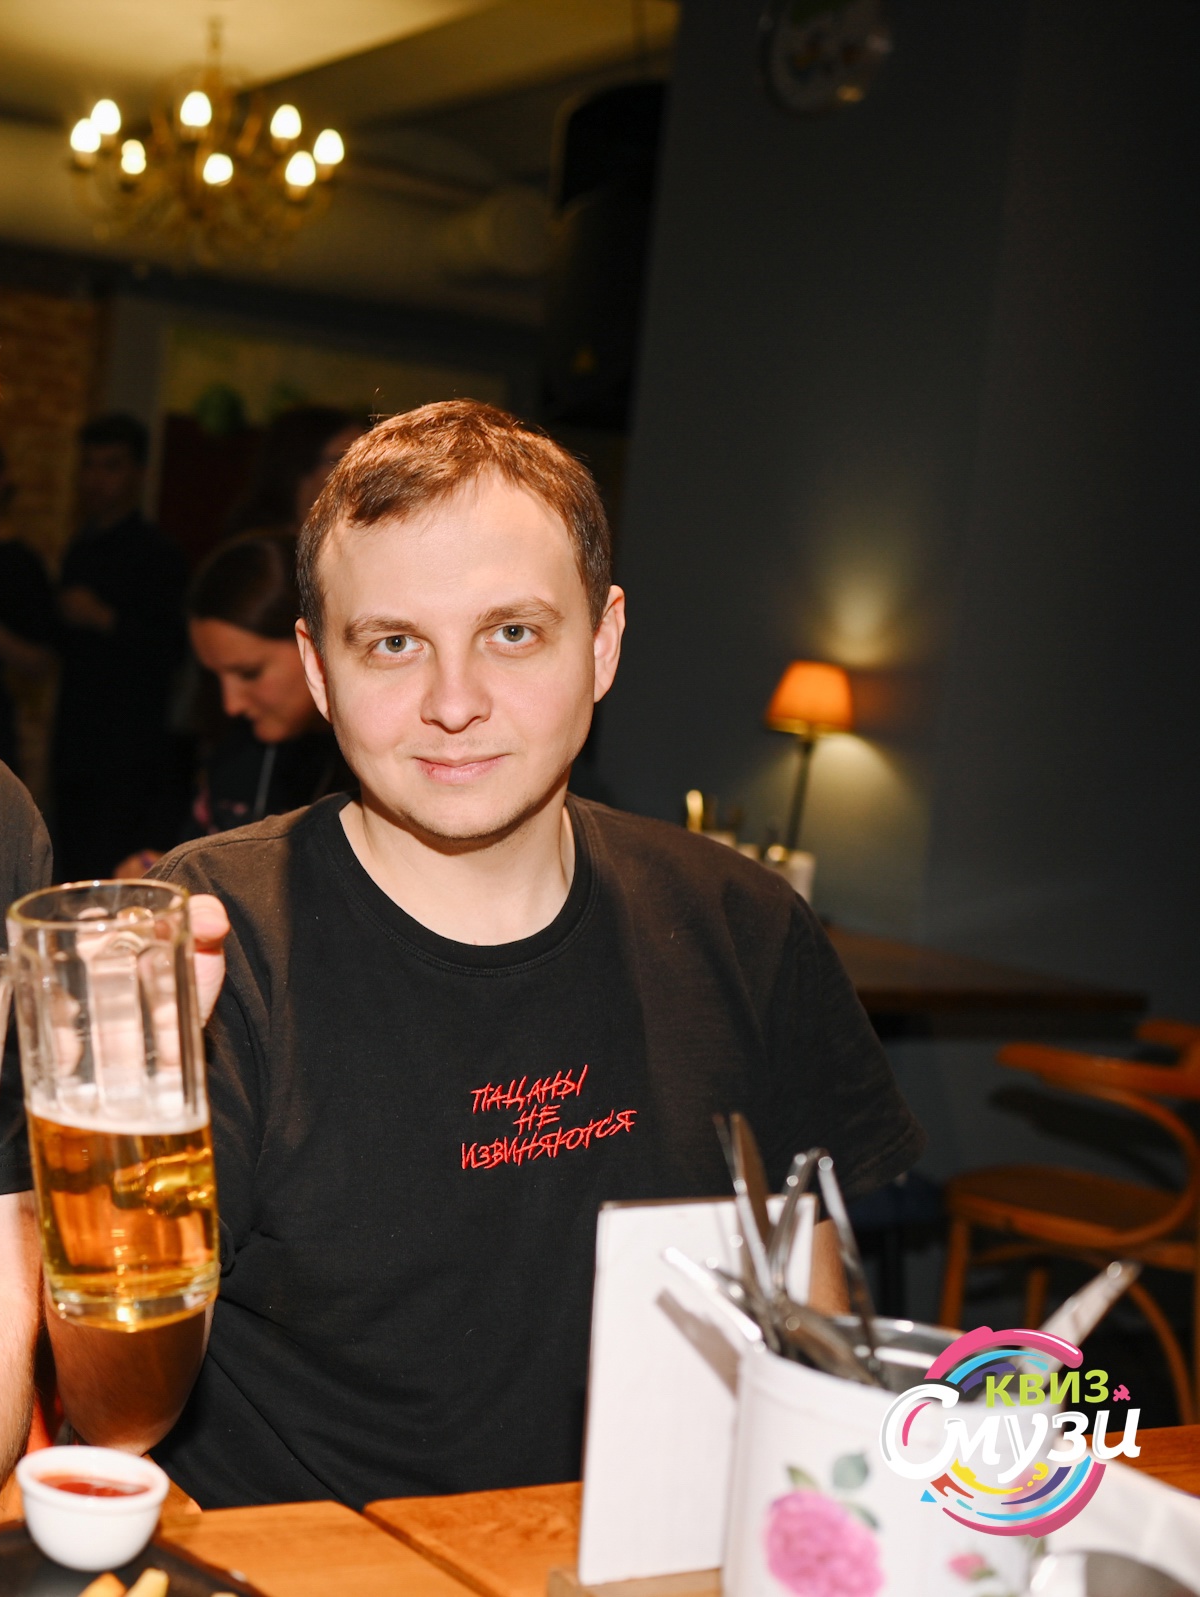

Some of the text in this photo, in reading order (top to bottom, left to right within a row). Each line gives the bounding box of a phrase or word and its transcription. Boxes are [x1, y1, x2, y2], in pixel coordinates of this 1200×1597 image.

[470, 1064, 588, 1114] ПАЦАНЫ
[461, 1109, 638, 1169] ИЗВИНЯЮТСЯ
[513, 1104, 560, 1135] НЕ
